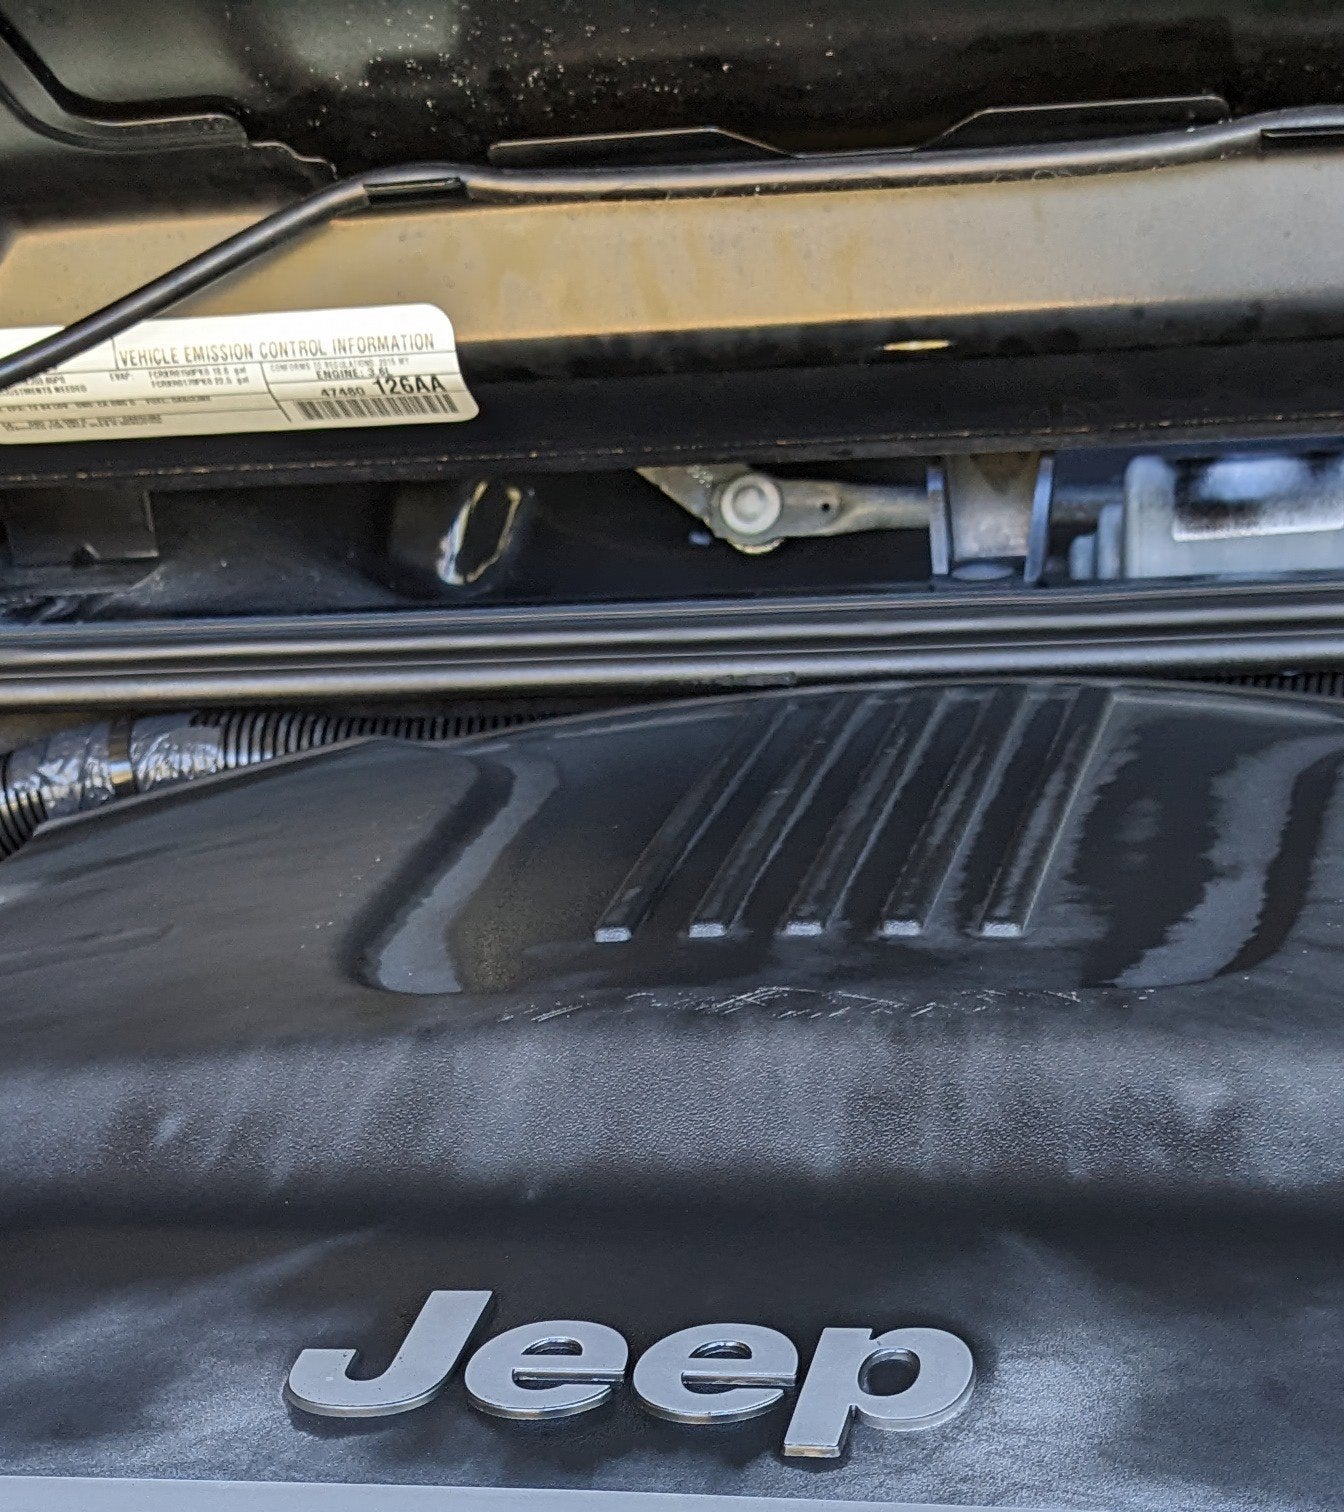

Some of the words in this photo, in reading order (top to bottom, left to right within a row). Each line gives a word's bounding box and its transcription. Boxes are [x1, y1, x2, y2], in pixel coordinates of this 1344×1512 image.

[118, 346, 180, 367] VEHICLE
[183, 342, 255, 363] EMISSION
[258, 338, 327, 359] CONTROL
[332, 333, 435, 355] INFORMATION
[372, 372, 448, 396] 126AA
[282, 1290, 975, 1458] Jeep
